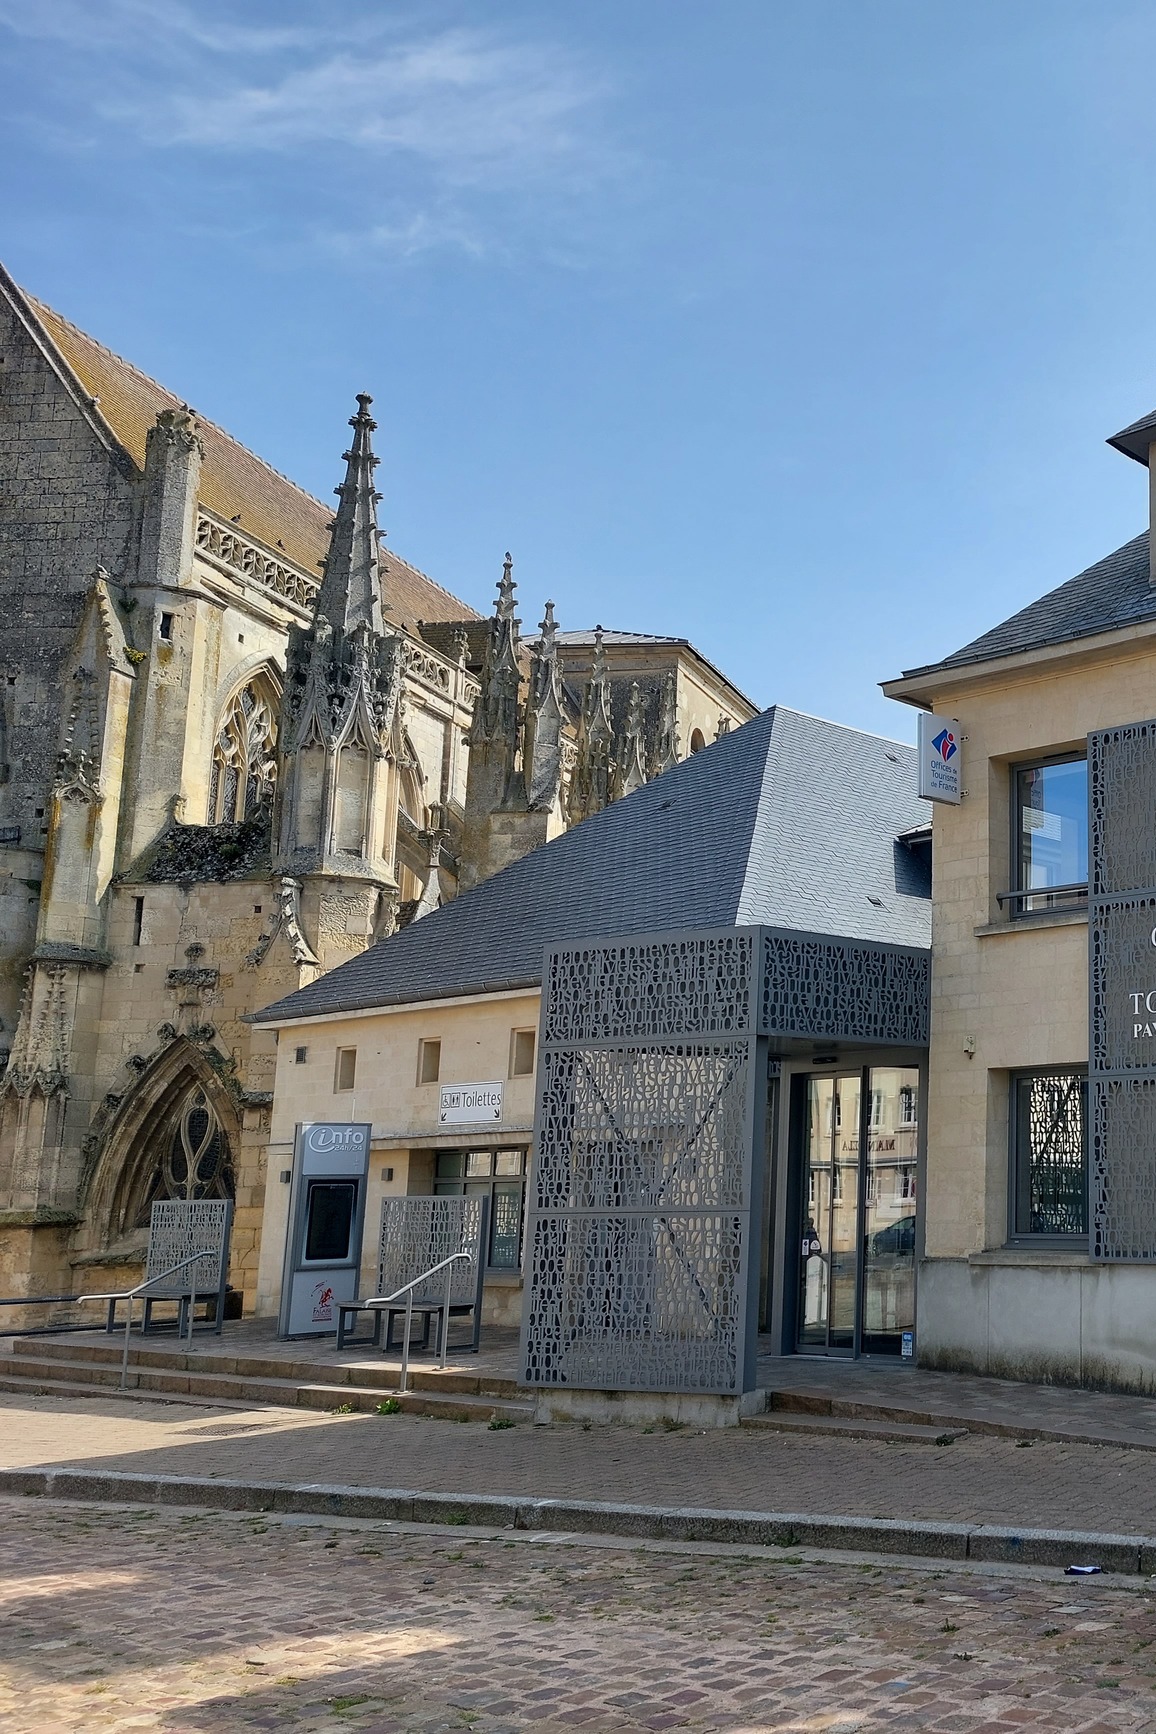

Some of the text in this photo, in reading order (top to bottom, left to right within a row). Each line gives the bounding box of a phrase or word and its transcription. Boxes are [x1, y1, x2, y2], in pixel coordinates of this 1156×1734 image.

[931, 760, 951, 773] Offices
[931, 769, 958, 784] Tourisme
[938, 780, 958, 793] France
[461, 1091, 502, 1108] Toilettes
